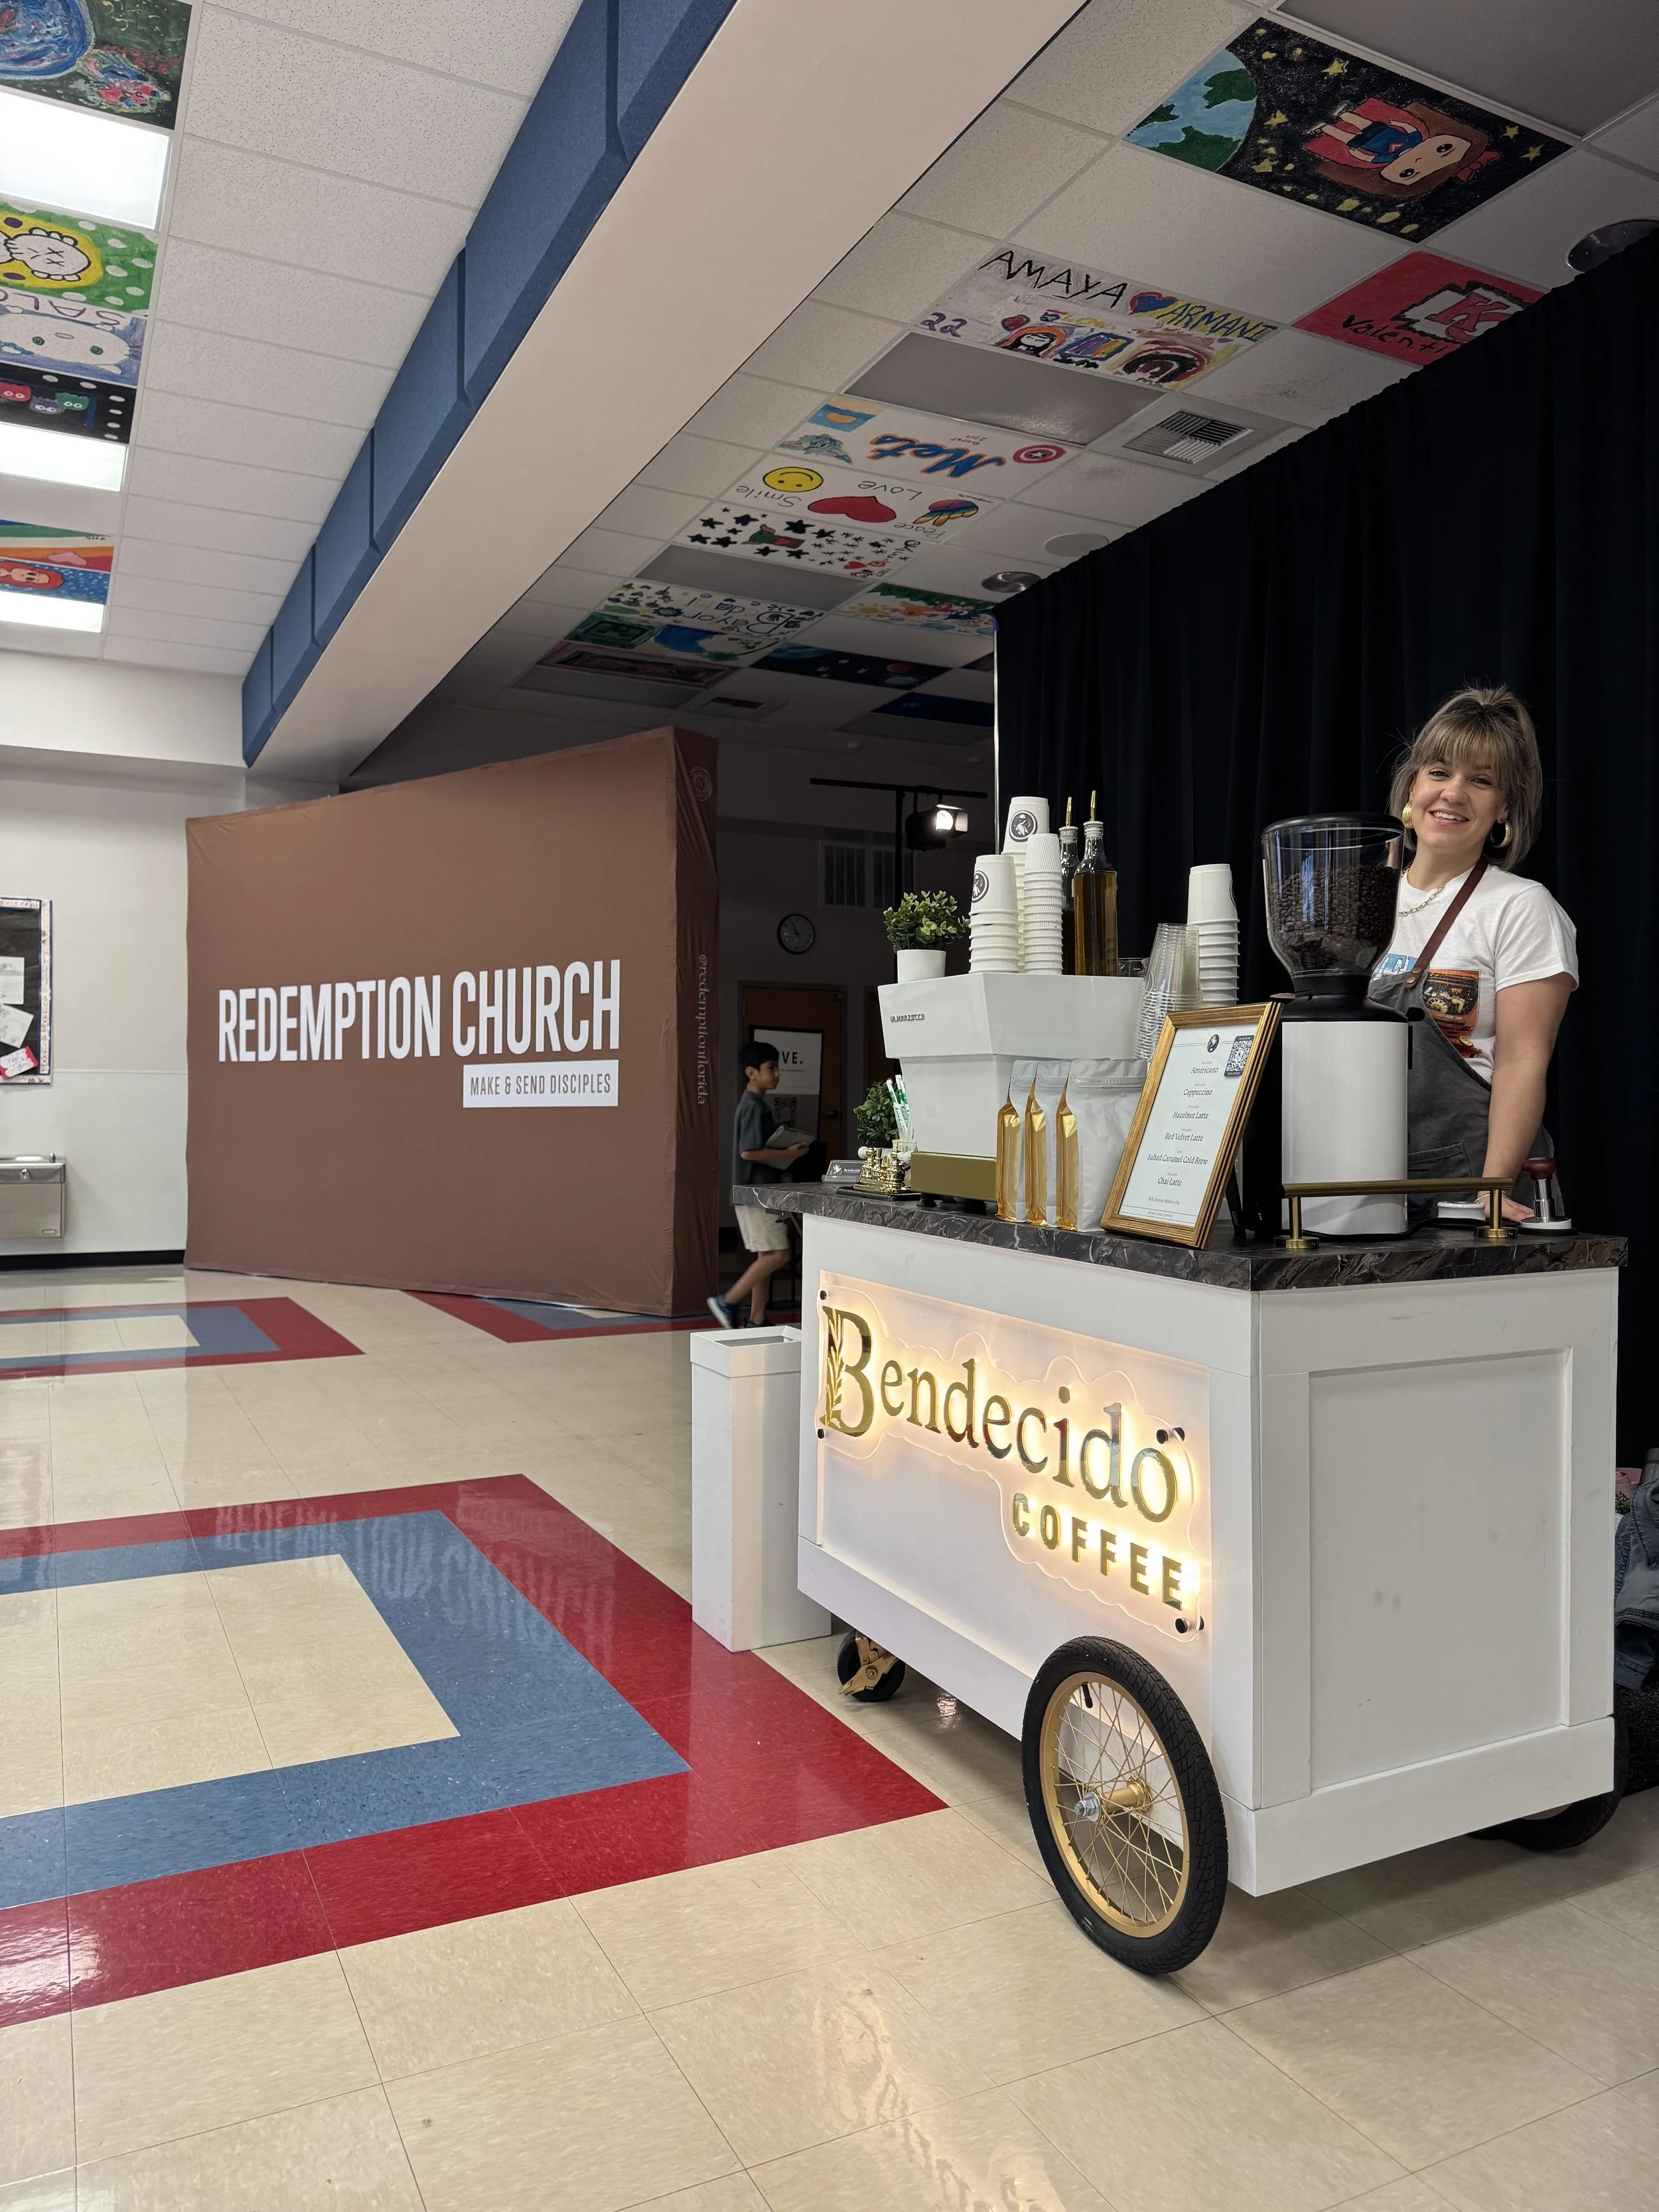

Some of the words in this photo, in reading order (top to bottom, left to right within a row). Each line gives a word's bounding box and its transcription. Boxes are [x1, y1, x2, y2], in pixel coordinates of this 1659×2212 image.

[977, 250, 1127, 309] AMAYA
[867, 433, 1007, 479] Mets
[735, 484, 802, 508] Smile
[857, 479, 923, 501] Love
[893, 522, 946, 540] Peace
[218, 974, 441, 1062] REDEMPTION
[452, 959, 620, 1057] CHURCH
[781, 1051, 804, 1065] VE.
[470, 1076, 500, 1096] MAKE
[504, 1075, 511, 1095] &
[516, 1074, 545, 1095] SEND
[550, 1073, 611, 1094] DISCIPLES
[1183, 1088, 1213, 1098] Cappuccino
[1147, 1153, 1163, 1161] Salted
[1162, 1154, 1183, 1163] Caramel
[820, 1306, 1178, 1524] Bendecido
[1012, 1492, 1183, 1611] COFFEE
